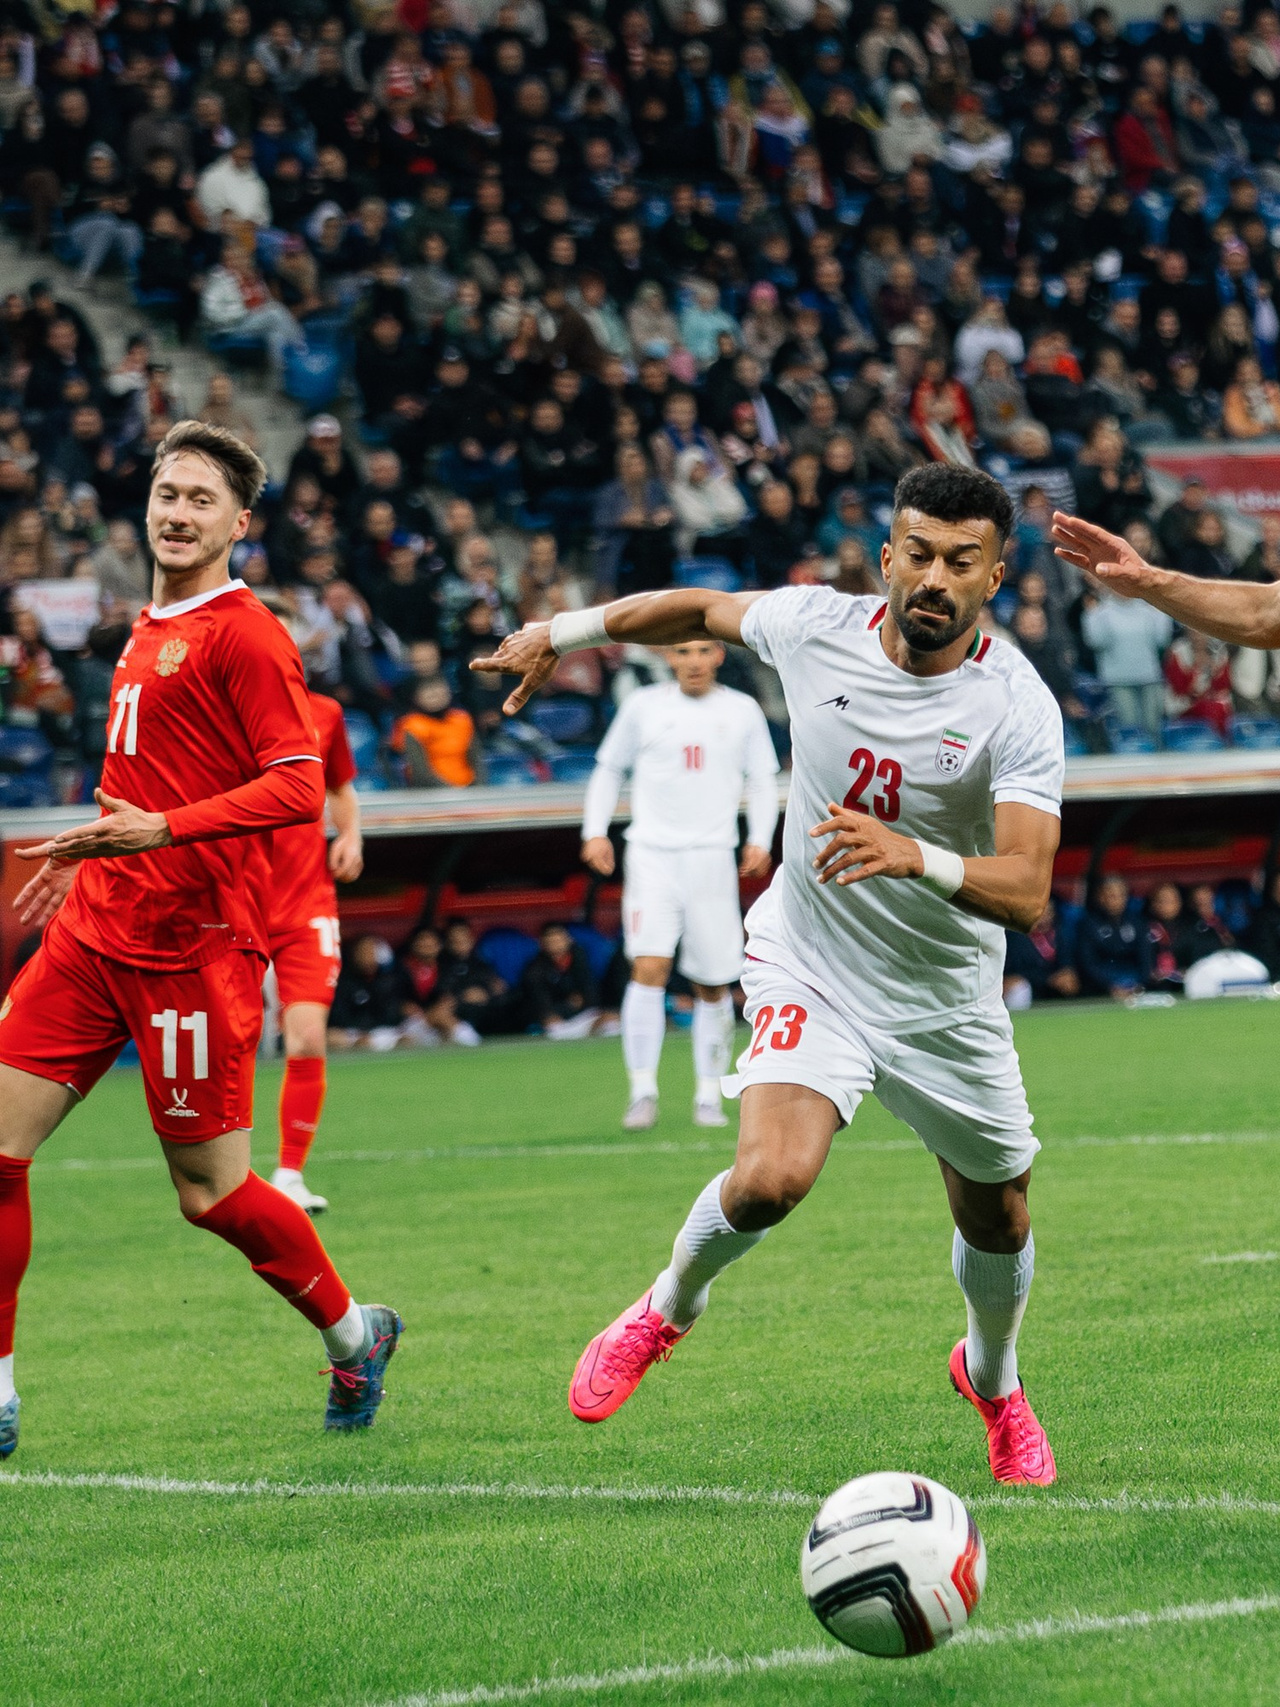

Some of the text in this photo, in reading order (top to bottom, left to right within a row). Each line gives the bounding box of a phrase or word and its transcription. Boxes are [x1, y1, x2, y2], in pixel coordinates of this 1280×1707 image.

[109, 683, 143, 756] 11
[683, 745, 704, 770] 10
[842, 747, 903, 823] 23
[151, 1008, 209, 1080] 11
[748, 1003, 808, 1064] 23
